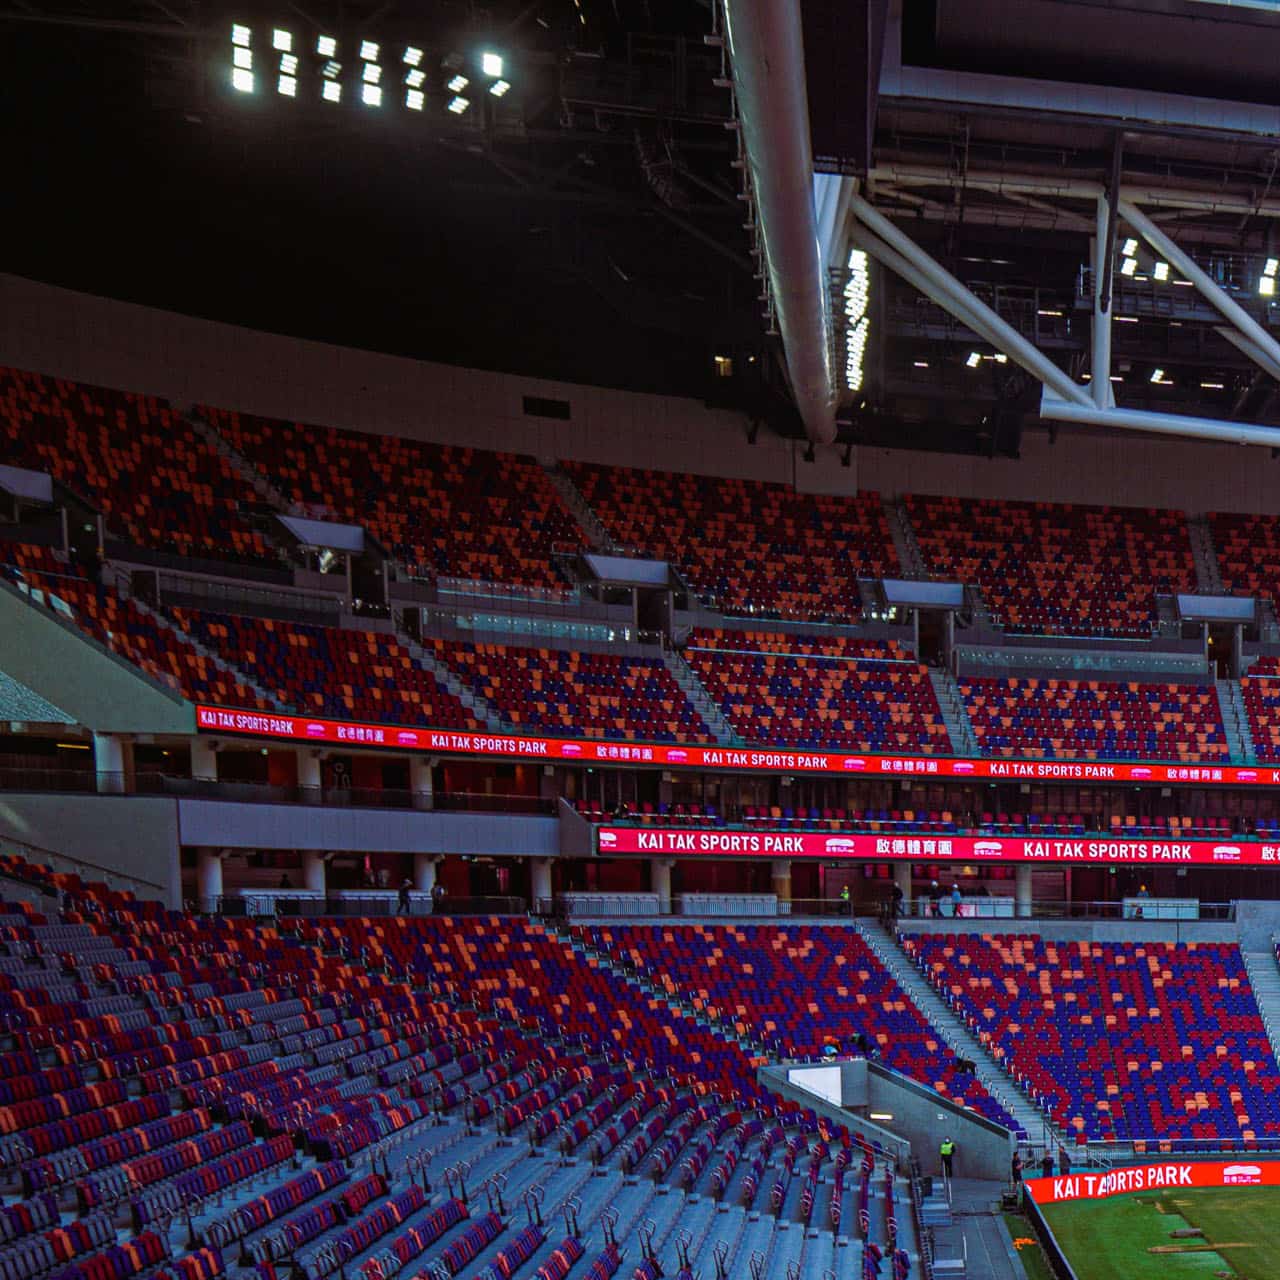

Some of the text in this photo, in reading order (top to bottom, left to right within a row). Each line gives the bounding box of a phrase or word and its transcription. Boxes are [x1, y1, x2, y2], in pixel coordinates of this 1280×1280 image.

[431, 734, 546, 754] KAI TAK SPORTS PARK
[702, 751, 827, 768] KAI TAK SPORTS PARK
[989, 762, 1114, 777] KAI TAK SPORTS PARK
[637, 832, 803, 852] KAI TAK SPORTS PARK
[1023, 841, 1191, 859] KAI TAK SPORTS PARK
[1053, 1176, 1080, 1200] KAI
[1147, 1165, 1193, 1188] PARK
